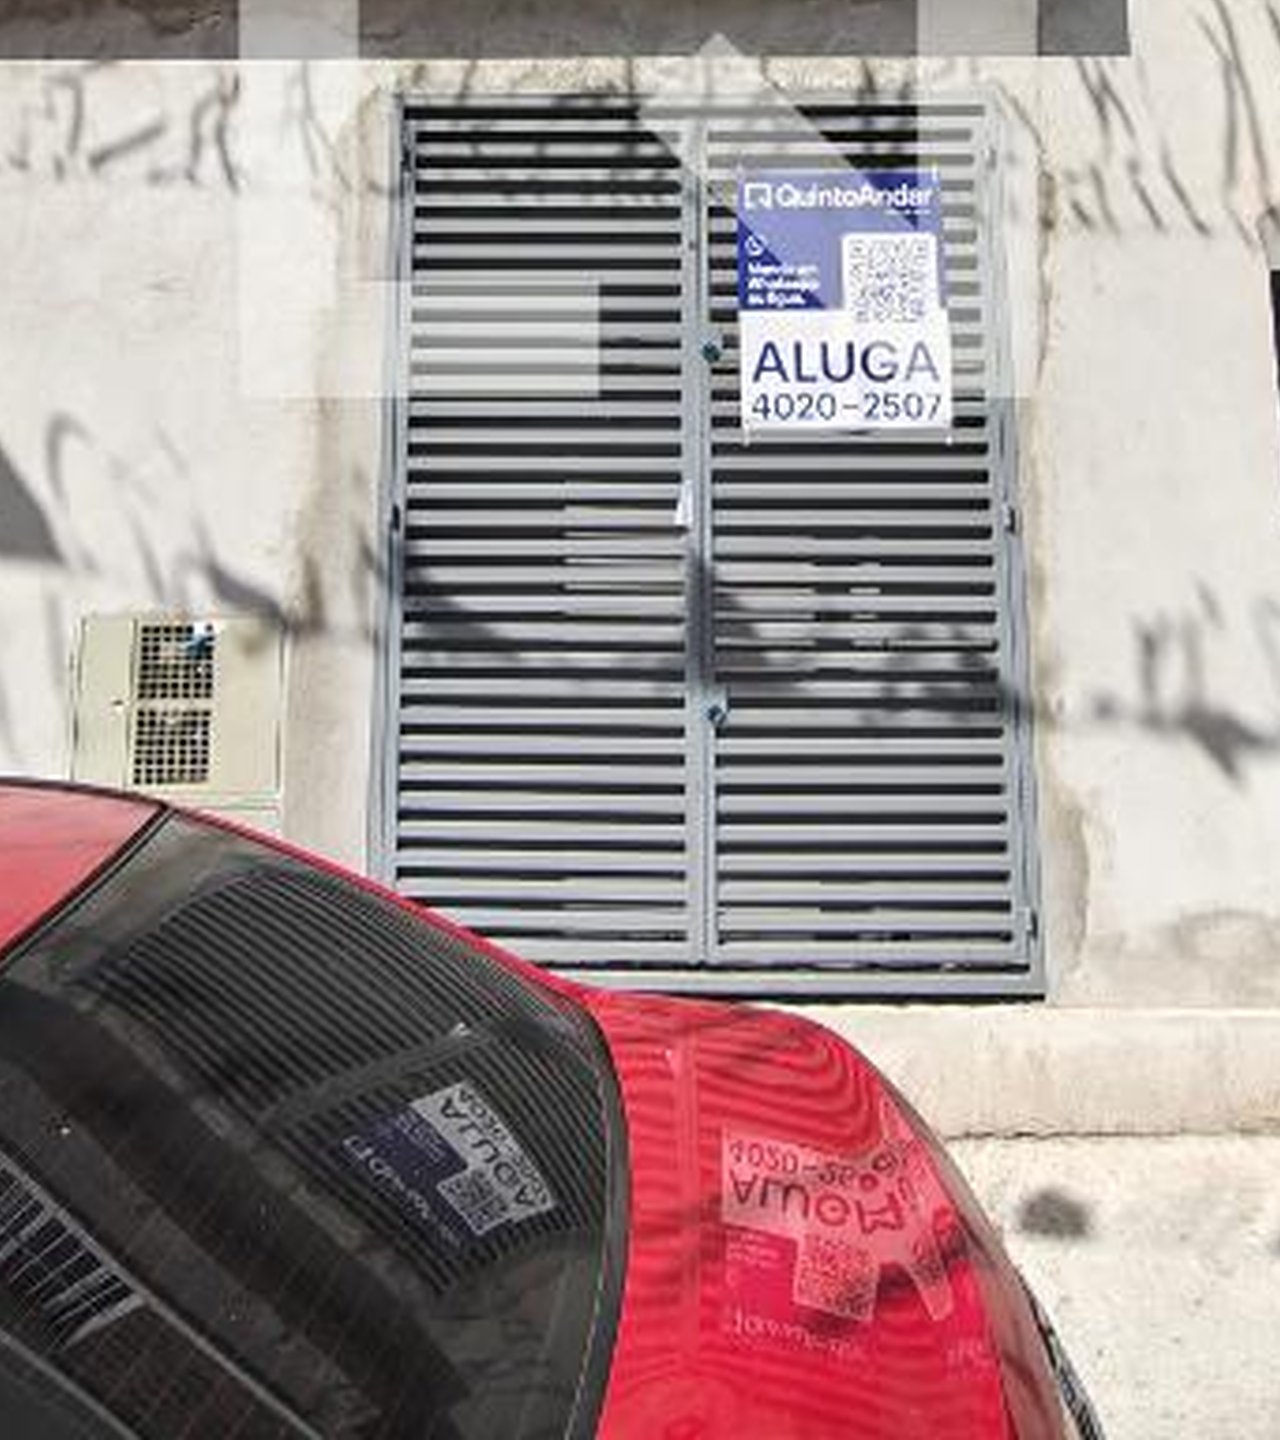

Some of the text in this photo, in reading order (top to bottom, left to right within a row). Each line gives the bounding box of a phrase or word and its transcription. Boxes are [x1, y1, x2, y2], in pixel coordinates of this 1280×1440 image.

[775, 182, 934, 209] QuintoAndar
[751, 340, 940, 384] ALUGA
[751, 392, 942, 421] 4020-2507
